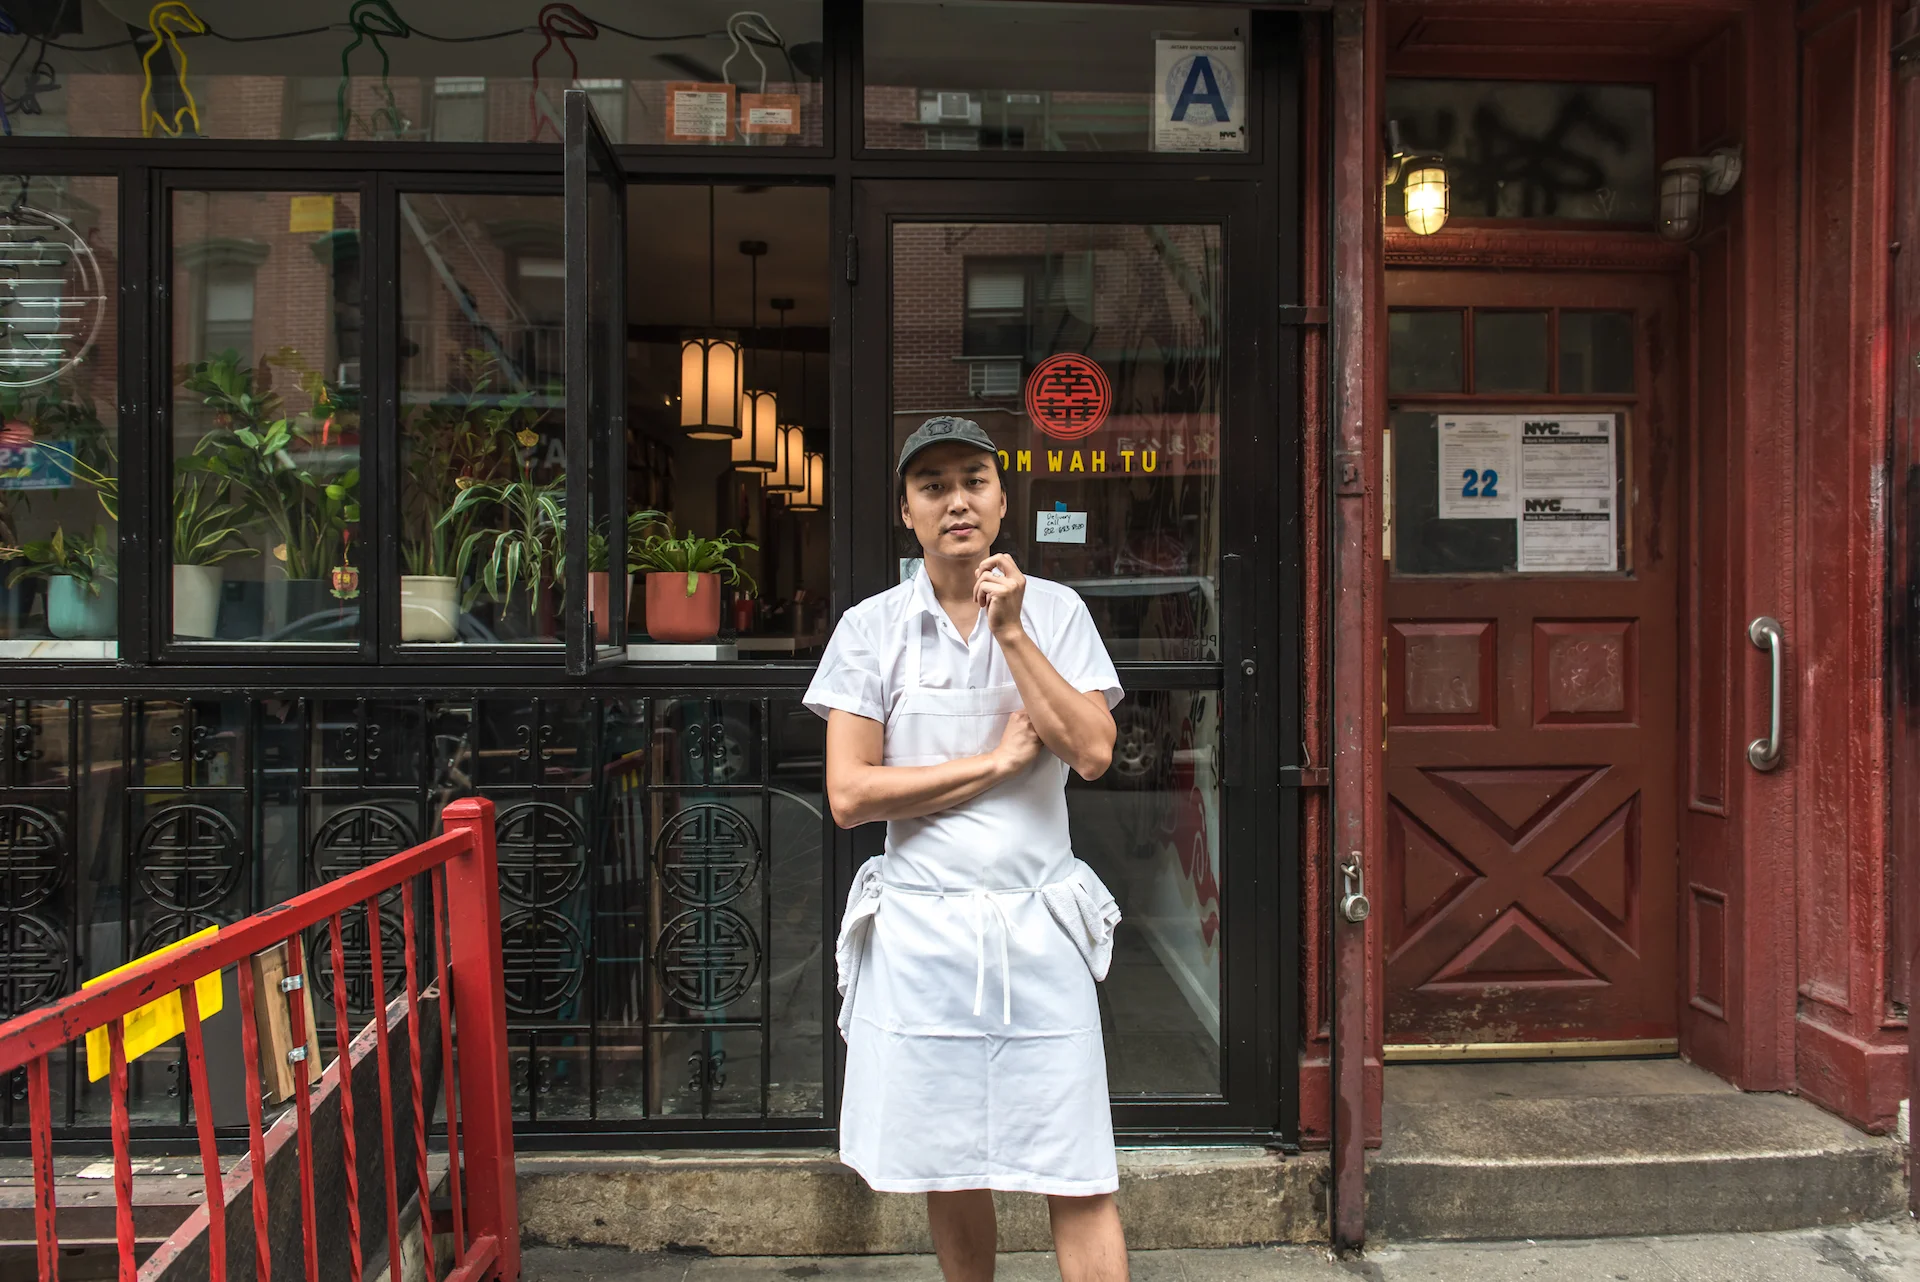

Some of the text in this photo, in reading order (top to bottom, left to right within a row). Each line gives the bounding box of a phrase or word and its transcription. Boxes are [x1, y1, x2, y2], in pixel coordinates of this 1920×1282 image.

[1170, 56, 1230, 122] A
[1524, 422, 1560, 435] NYC
[997, 450, 1032, 472] OM
[1047, 450, 1106, 472] WAH
[1120, 450, 1157, 473] TU
[1462, 468, 1498, 497] 22
[1525, 499, 1561, 512] NYC
[1047, 513, 1071, 523] Delivery
